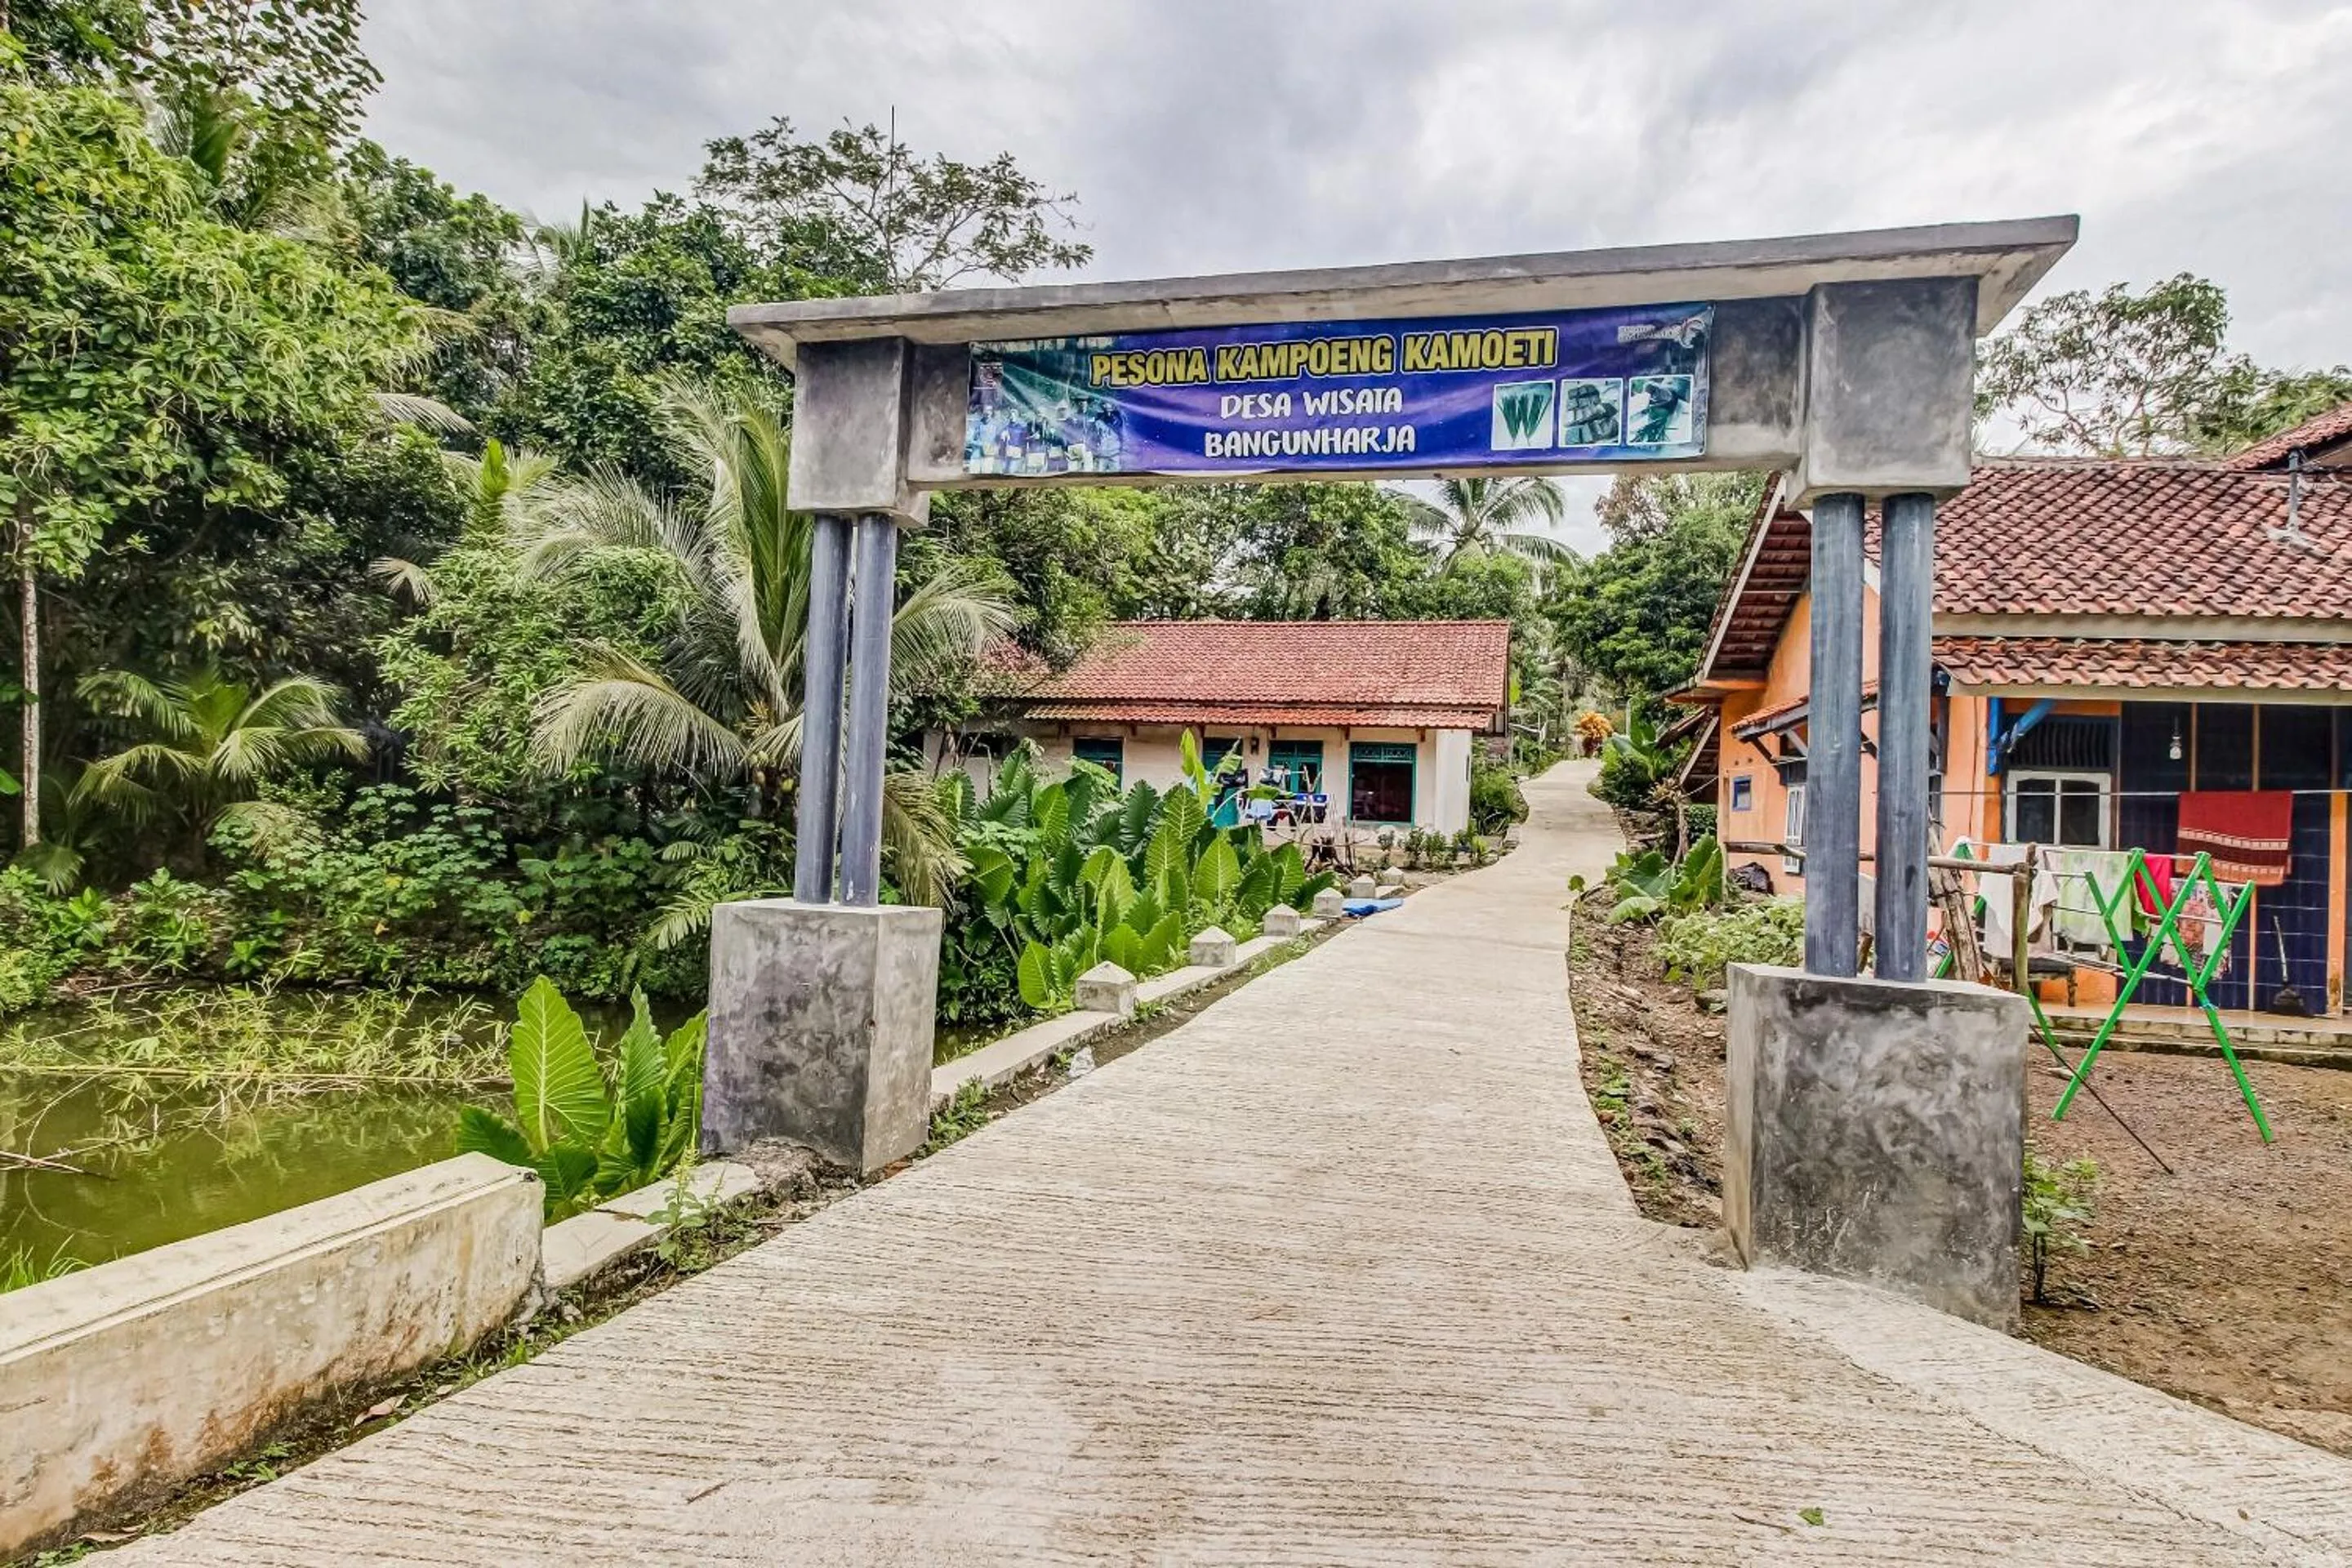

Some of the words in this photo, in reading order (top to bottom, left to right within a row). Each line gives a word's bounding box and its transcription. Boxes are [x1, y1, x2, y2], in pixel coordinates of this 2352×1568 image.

[1091, 348, 1209, 386] PESONA
[1218, 337, 1392, 382] KAMPOENG
[1403, 328, 1556, 372] KAMOETI
[1221, 393, 1291, 419] DESA
[1303, 388, 1402, 416] WISATA
[1205, 425, 1415, 457] BANGUNHARJA
